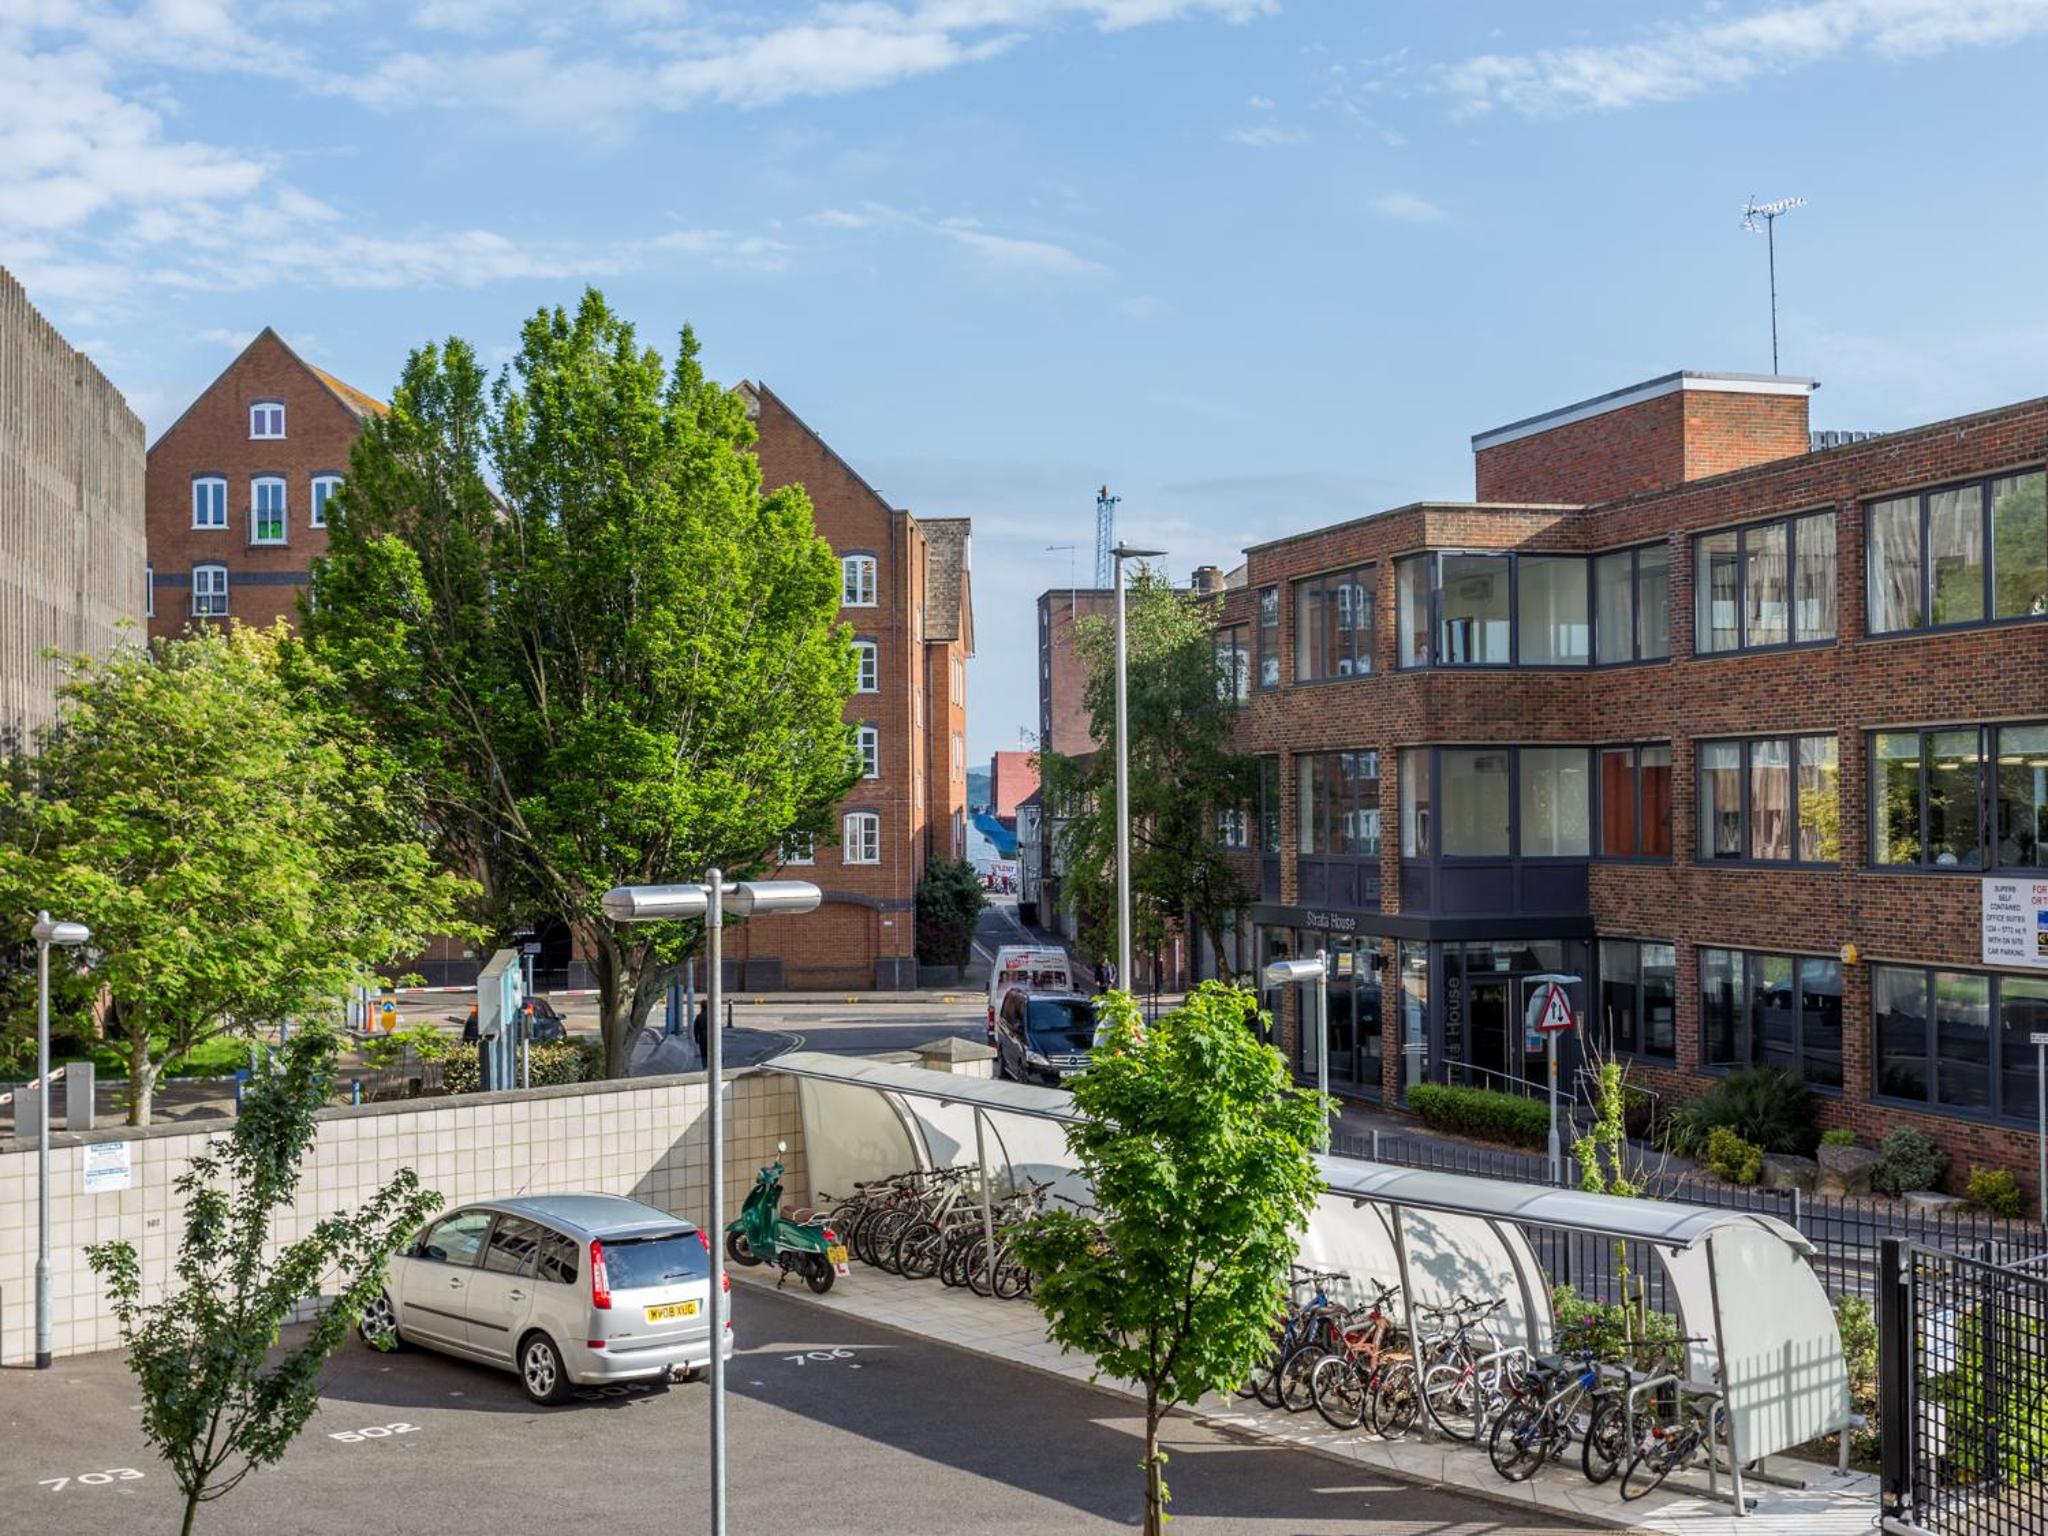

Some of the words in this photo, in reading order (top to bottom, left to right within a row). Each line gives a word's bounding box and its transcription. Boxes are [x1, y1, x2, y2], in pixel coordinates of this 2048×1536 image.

[1993, 885, 2017, 893] SUPERB
[1998, 894, 2012, 902] SELF
[2031, 896, 2042, 905] OR
[1990, 903, 2021, 911] CONTAINED
[1305, 911, 1329, 928] Strata
[1330, 912, 1356, 930] House
[1986, 914, 2005, 922] OFFICE
[2006, 915, 2025, 923] SUITES
[1987, 936, 2002, 944] WITH
[1987, 947, 1999, 955] CAR
[2000, 948, 2025, 956] PARKING
[1446, 976, 1461, 1037] House
[783, 1348, 855, 1366] 706
[328, 1422, 422, 1443] 502
[38, 1468, 145, 1492] 703
